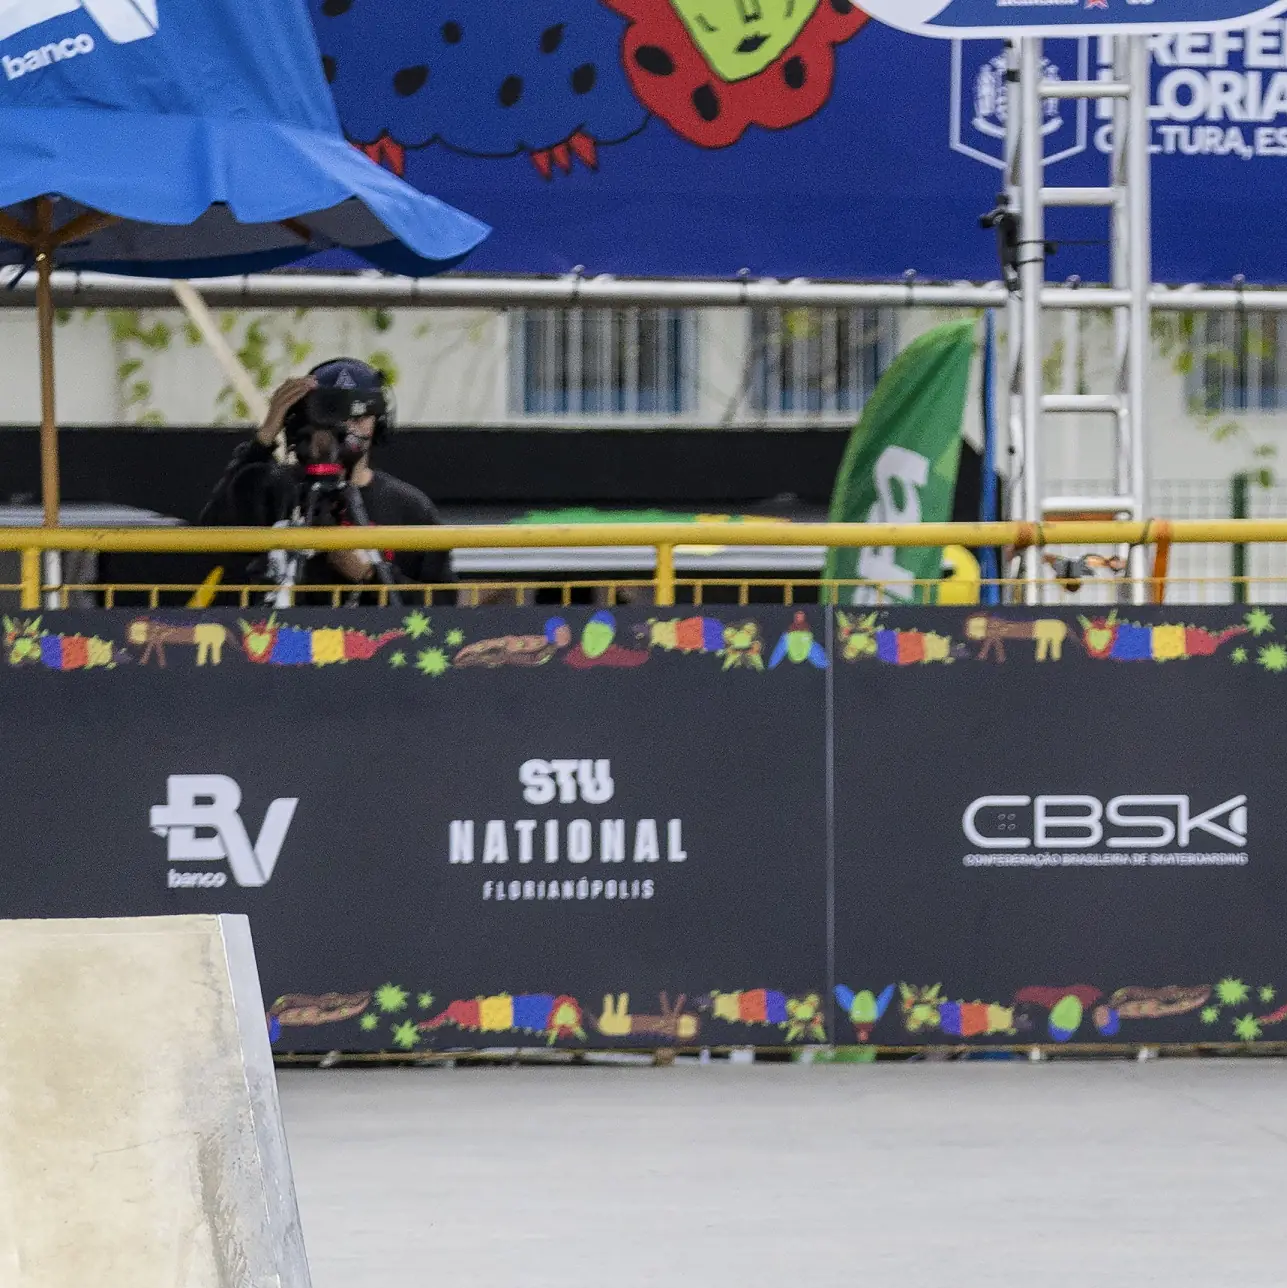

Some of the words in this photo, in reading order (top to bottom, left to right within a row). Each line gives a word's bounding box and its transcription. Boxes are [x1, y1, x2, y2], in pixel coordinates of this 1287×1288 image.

[2, 33, 95, 80] banco
[519, 759, 615, 805] STU
[149, 774, 299, 887] BV
[449, 819, 688, 864] NATIONAL
[168, 868, 227, 888] banco
[482, 876, 655, 901] FLORIANÓPOLIS
